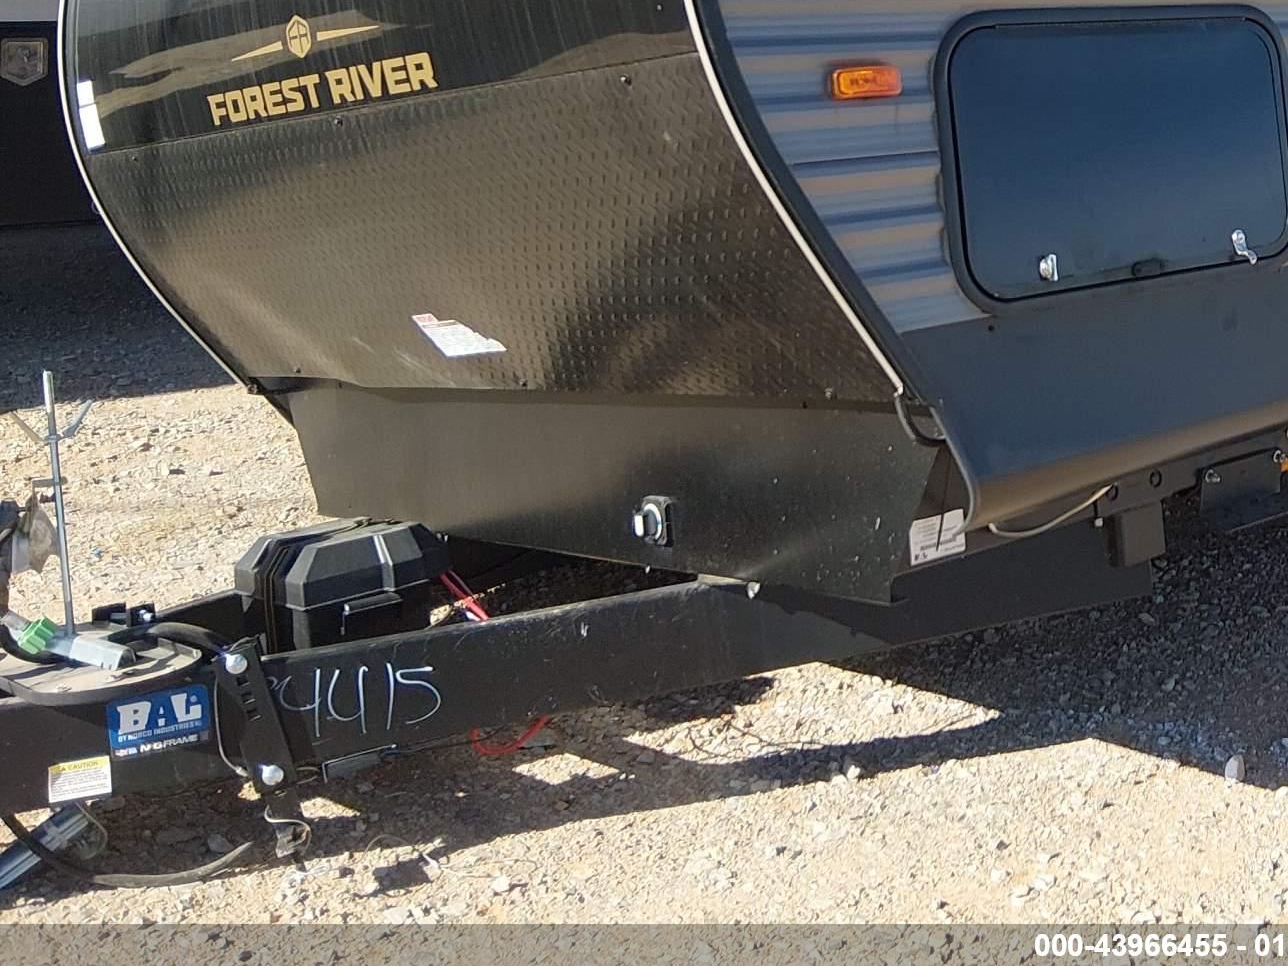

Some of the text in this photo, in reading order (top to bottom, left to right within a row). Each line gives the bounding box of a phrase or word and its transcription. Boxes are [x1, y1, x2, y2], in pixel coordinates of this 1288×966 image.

[206, 51, 439, 127] FOREST RIVER
[116, 692, 203, 734] BAL
[68, 760, 99, 771] CAUTION
